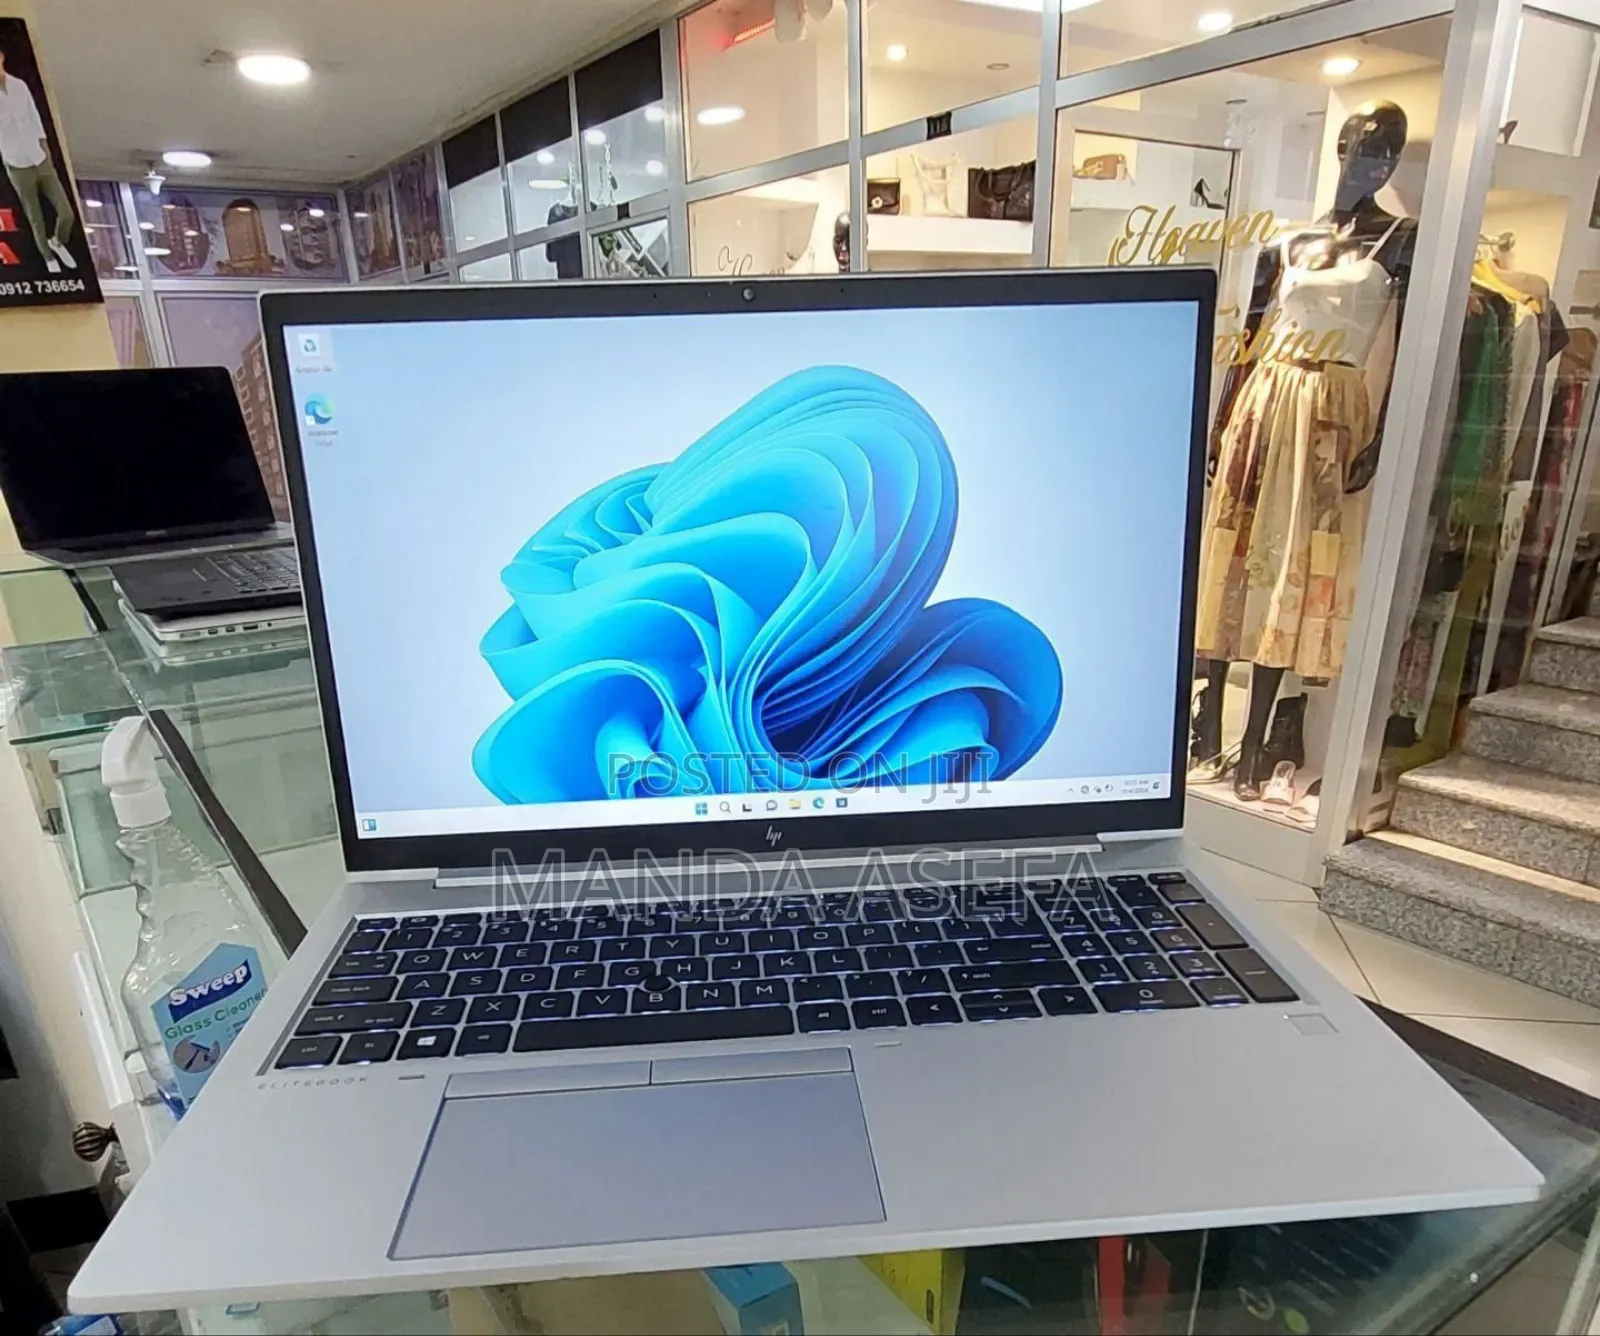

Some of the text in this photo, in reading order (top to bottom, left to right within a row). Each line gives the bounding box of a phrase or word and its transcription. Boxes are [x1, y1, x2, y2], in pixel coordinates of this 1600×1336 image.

[34, 278, 85, 294] 736654
[462, 951, 484, 961] W
[516, 948, 529, 958] E
[565, 946, 580, 954] R
[617, 942, 630, 951] T
[666, 939, 680, 948] Y
[715, 937, 729, 946] U
[863, 928, 876, 936] P
[168, 964, 248, 1007] Sweep
[414, 954, 844, 990] A S D F G H J K L
[431, 1004, 447, 1016] Z
[485, 1001, 502, 1012] X
[540, 998, 556, 1008] C
[594, 994, 611, 1004] V
[649, 992, 664, 1003] B
[703, 988, 719, 998] N
[756, 984, 773, 995] M
[164, 1016, 213, 1040] Glass
